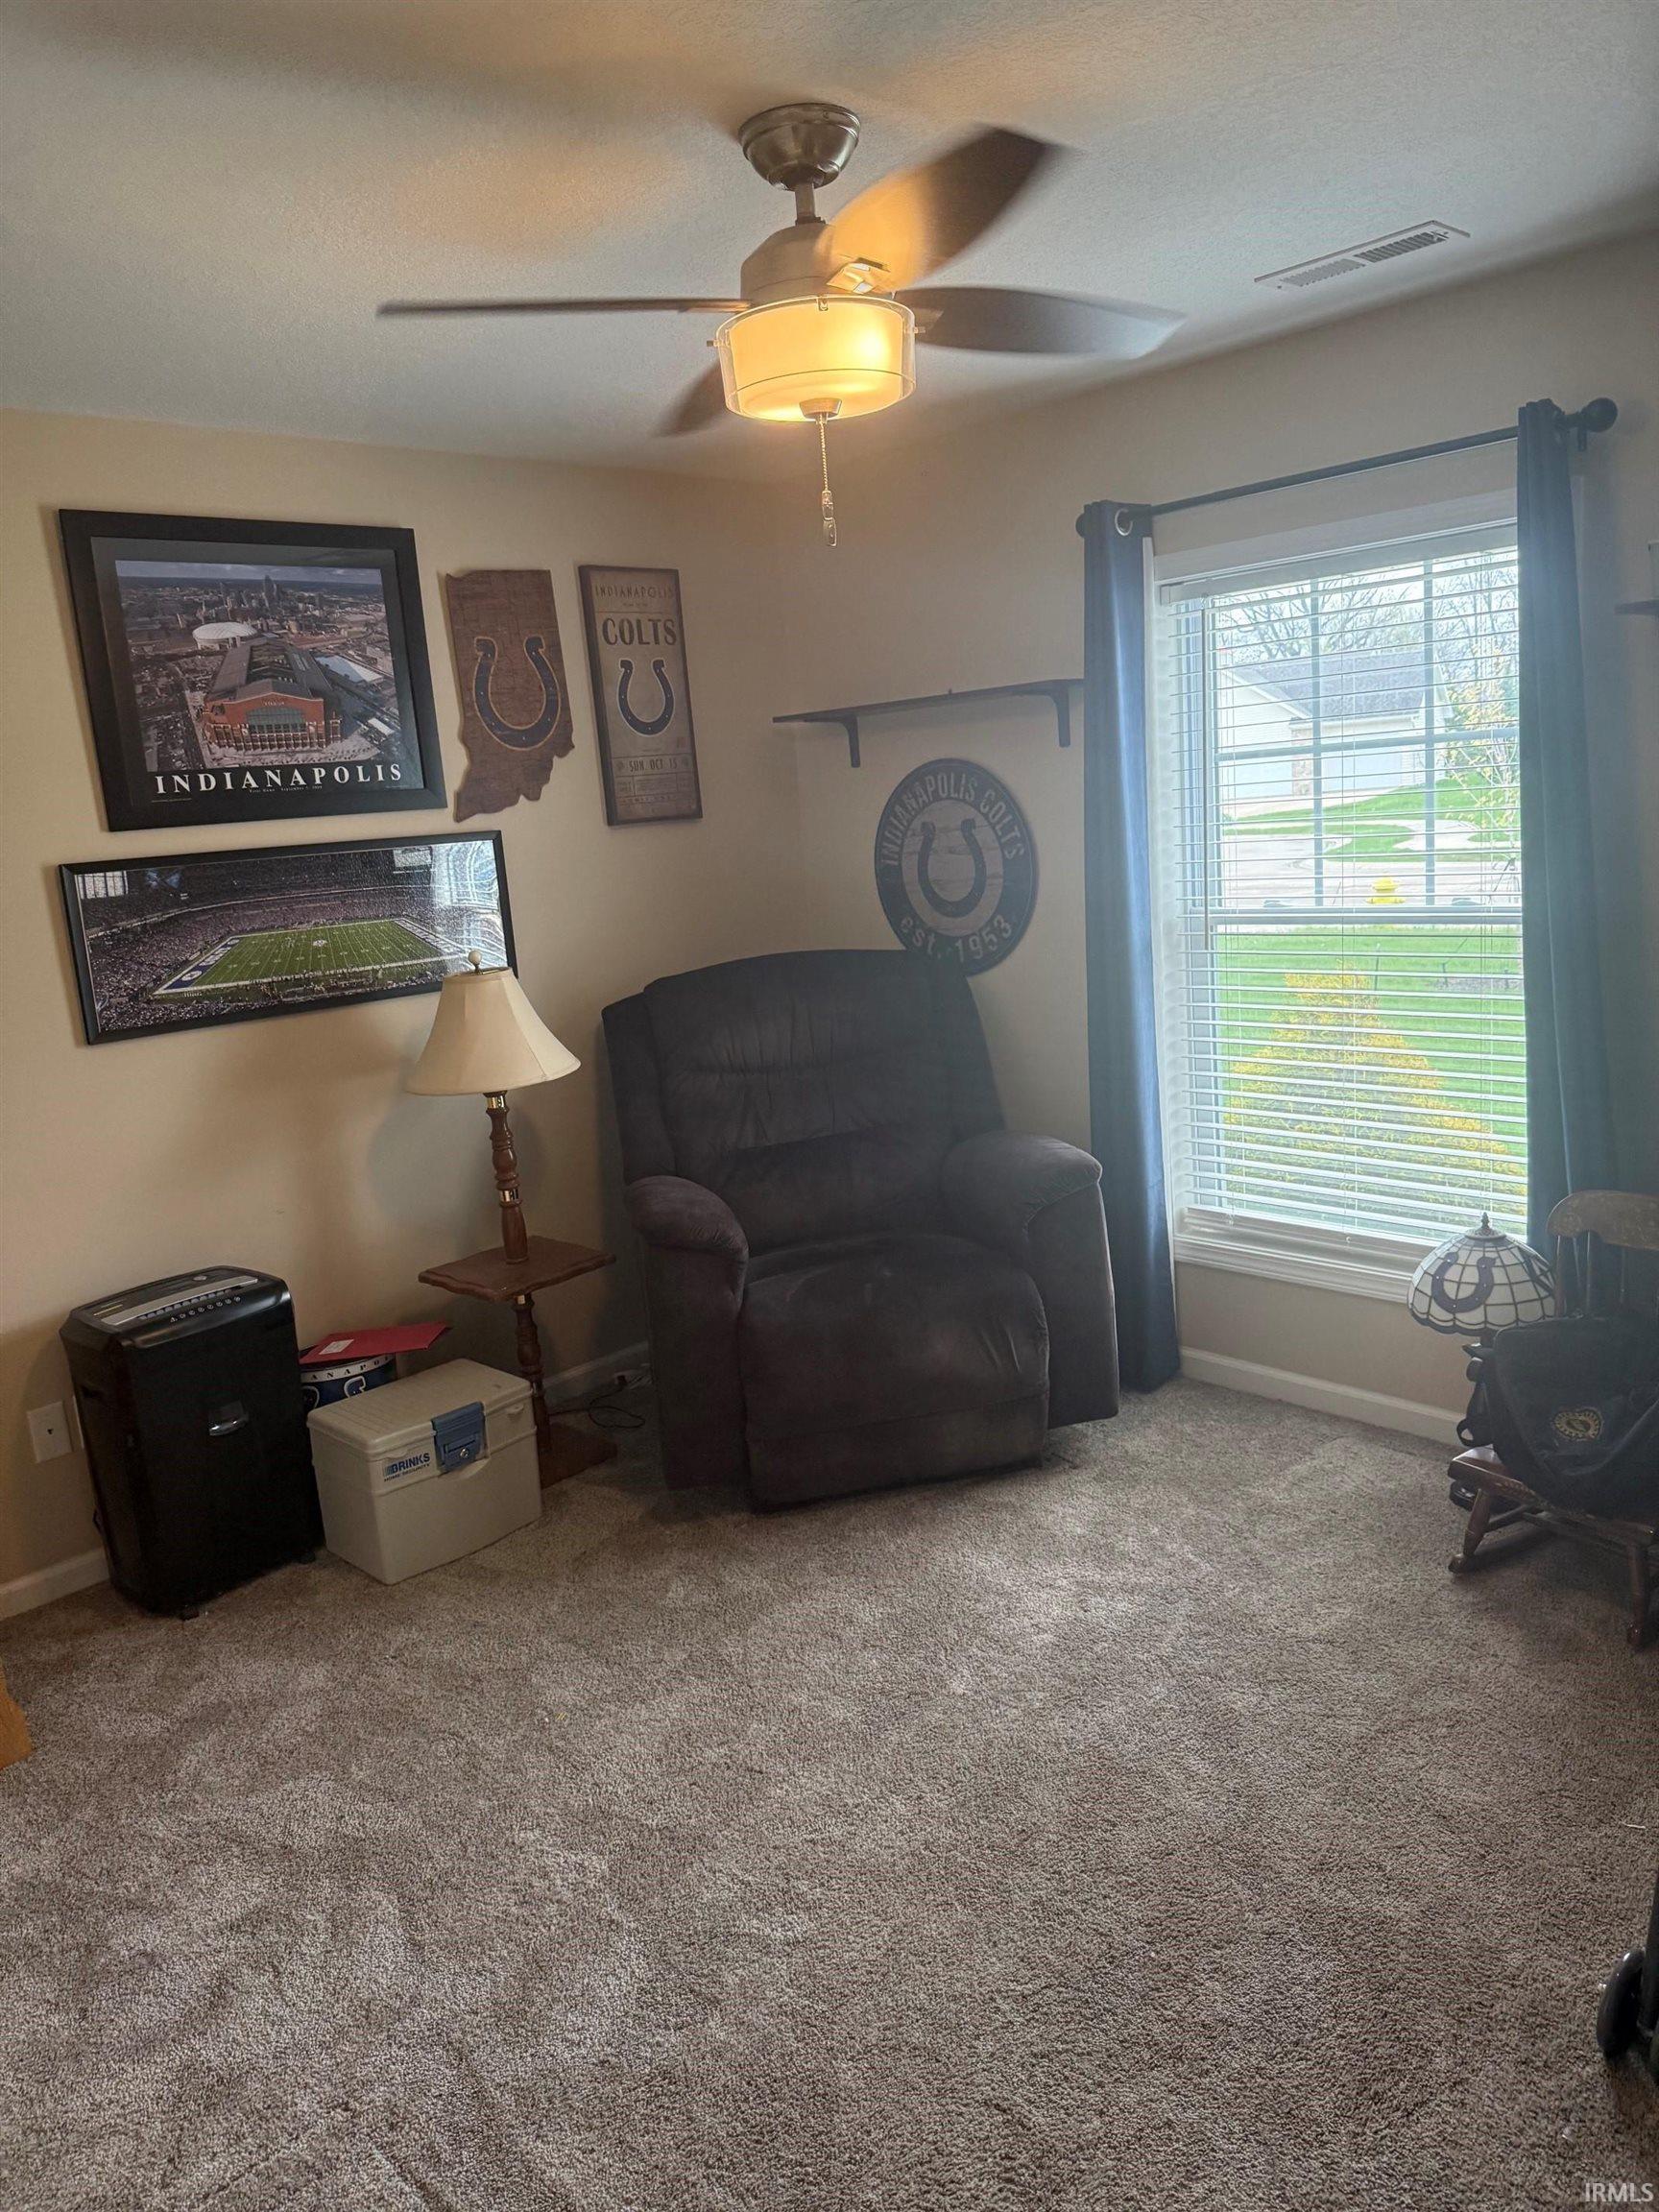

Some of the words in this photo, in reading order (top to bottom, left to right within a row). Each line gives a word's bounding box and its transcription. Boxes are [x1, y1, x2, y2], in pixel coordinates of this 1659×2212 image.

[595, 584, 675, 599] INDIANAPOLIS
[602, 617, 677, 646] COLTS
[649, 757, 663, 770] OCT
[669, 757, 678, 769] 15
[155, 763, 402, 794] INDIANAPOLIS
[880, 771, 978, 866] INDIANAPOLIS
[979, 789, 1025, 860] COLTS
[954, 914, 1013, 963] 1953
[392, 1453, 431, 1475] BRINKS
